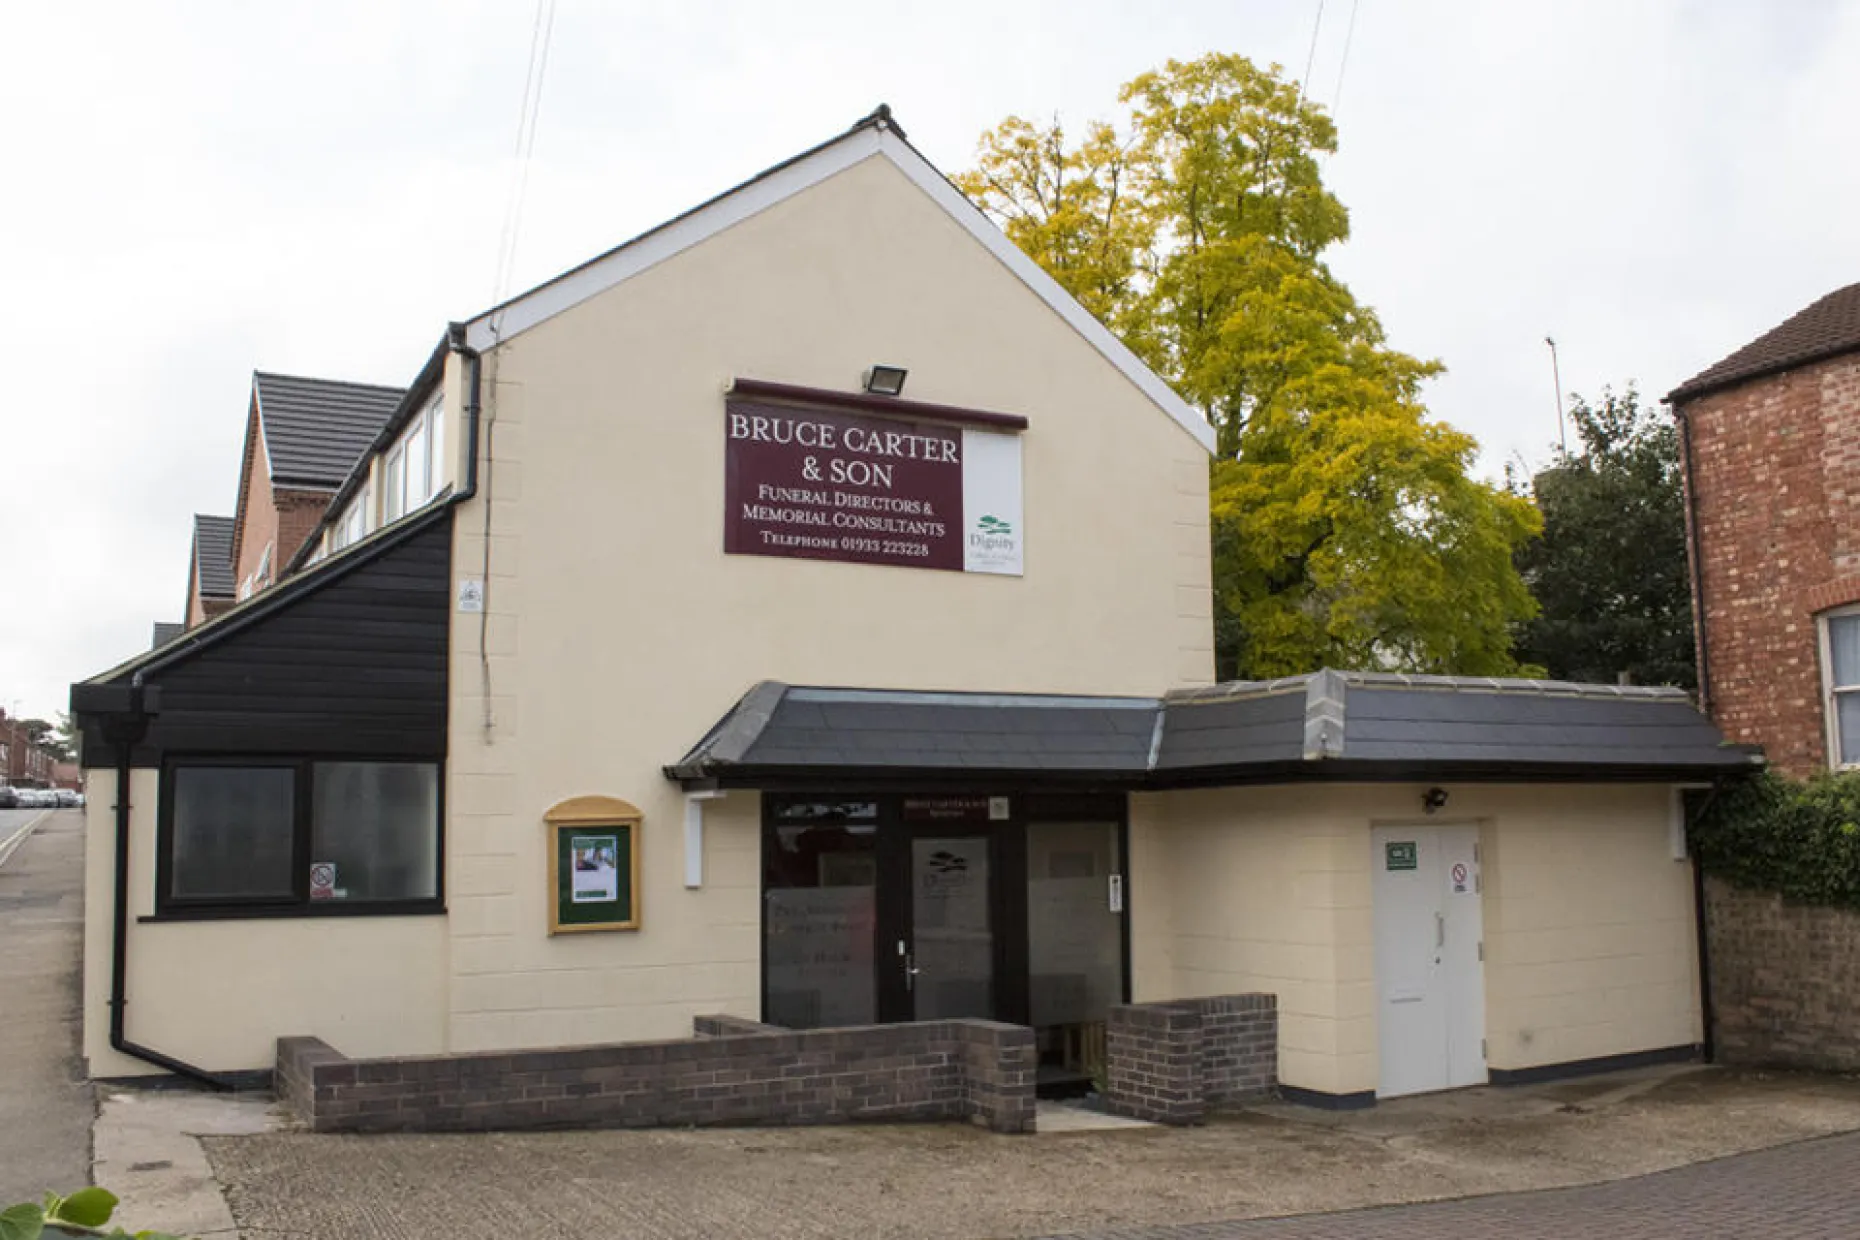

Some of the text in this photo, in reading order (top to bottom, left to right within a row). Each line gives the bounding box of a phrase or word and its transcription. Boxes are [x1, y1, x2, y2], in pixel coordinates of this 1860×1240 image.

[730, 413, 960, 465] BRUCE CARTER
[801, 456, 894, 489] & SON
[758, 484, 832, 506] FUNERAL
[834, 491, 921, 513] DIRECTORS
[743, 505, 946, 536] MEMORIAL CONSULTANTS
[760, 530, 838, 551] TELEPHONE
